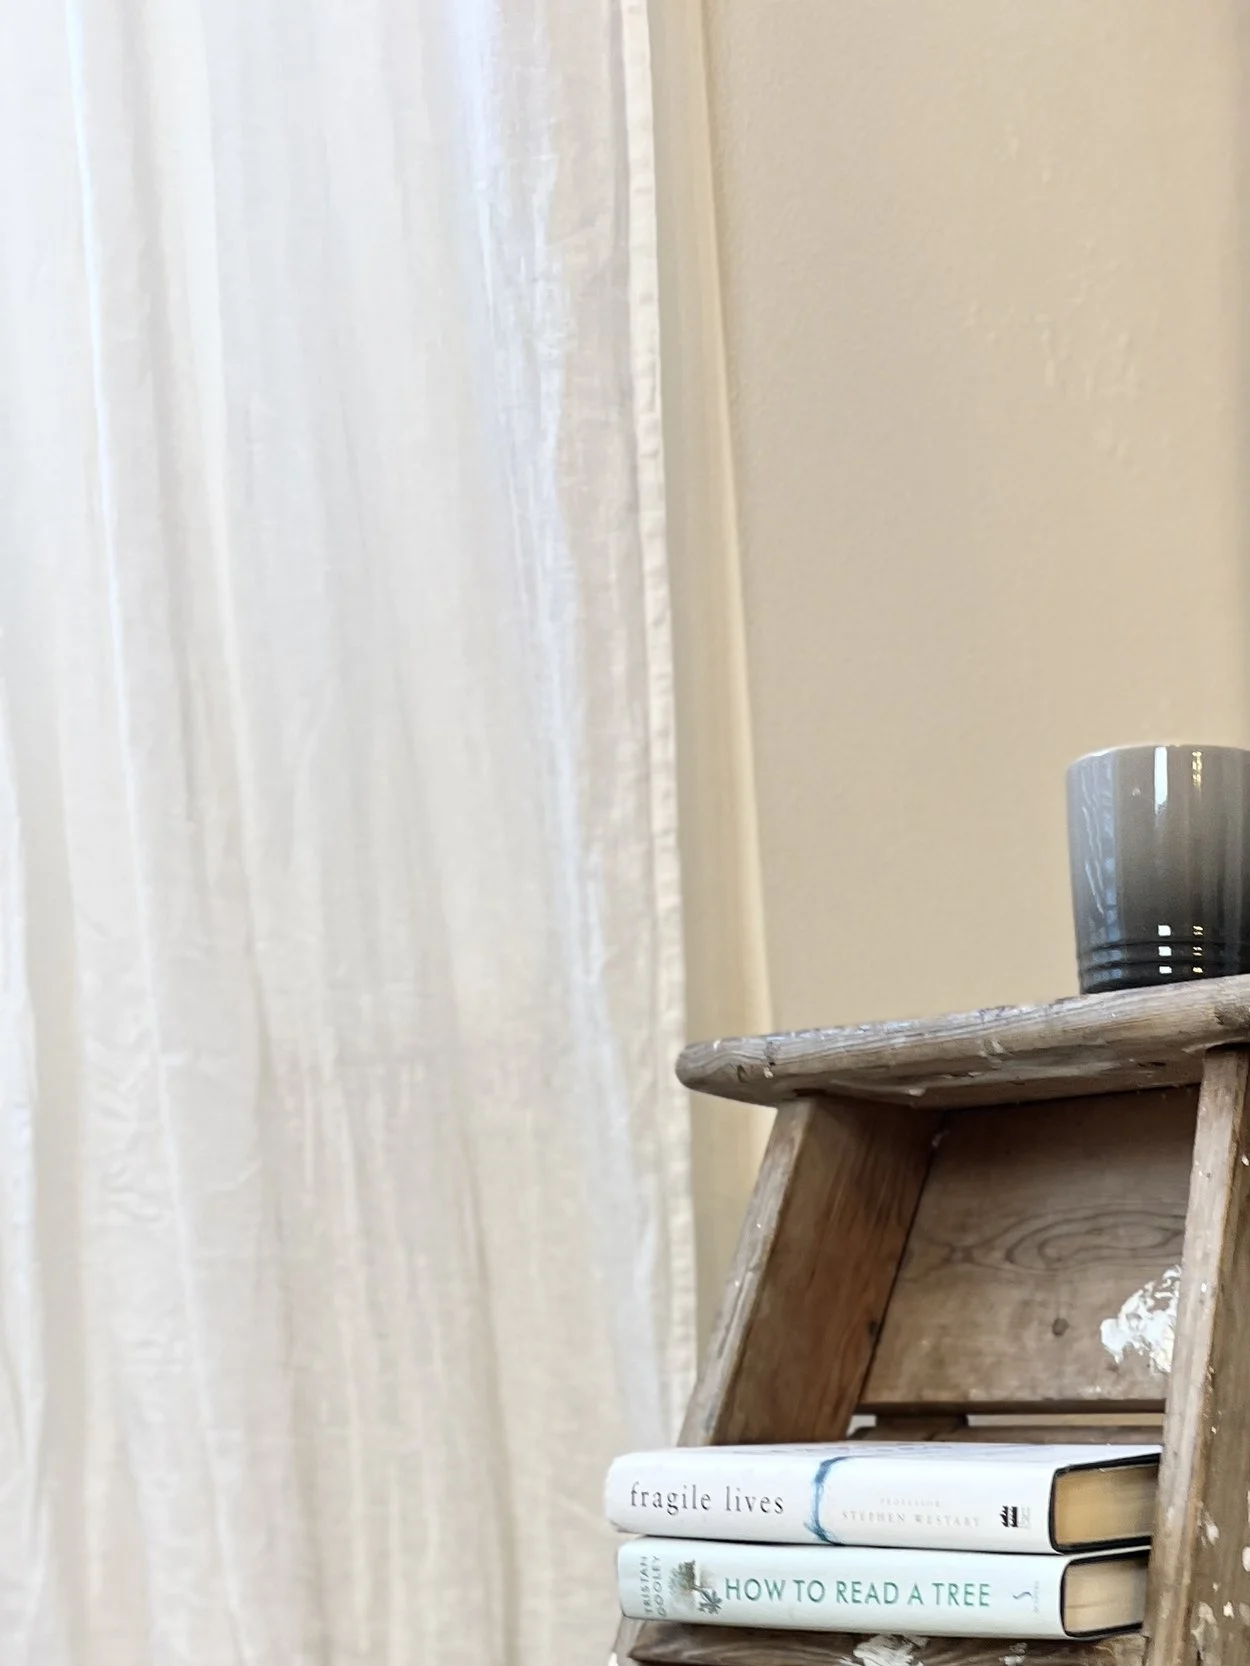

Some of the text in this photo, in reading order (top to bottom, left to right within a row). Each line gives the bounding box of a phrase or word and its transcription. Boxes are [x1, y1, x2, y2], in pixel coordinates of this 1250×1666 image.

[630, 1480, 785, 1517] fragile lives
[841, 1509, 906, 1524] STEPHEN
[639, 1555, 655, 1615] TRISTAN
[724, 1577, 992, 1608] HOW TO READ A TREE
